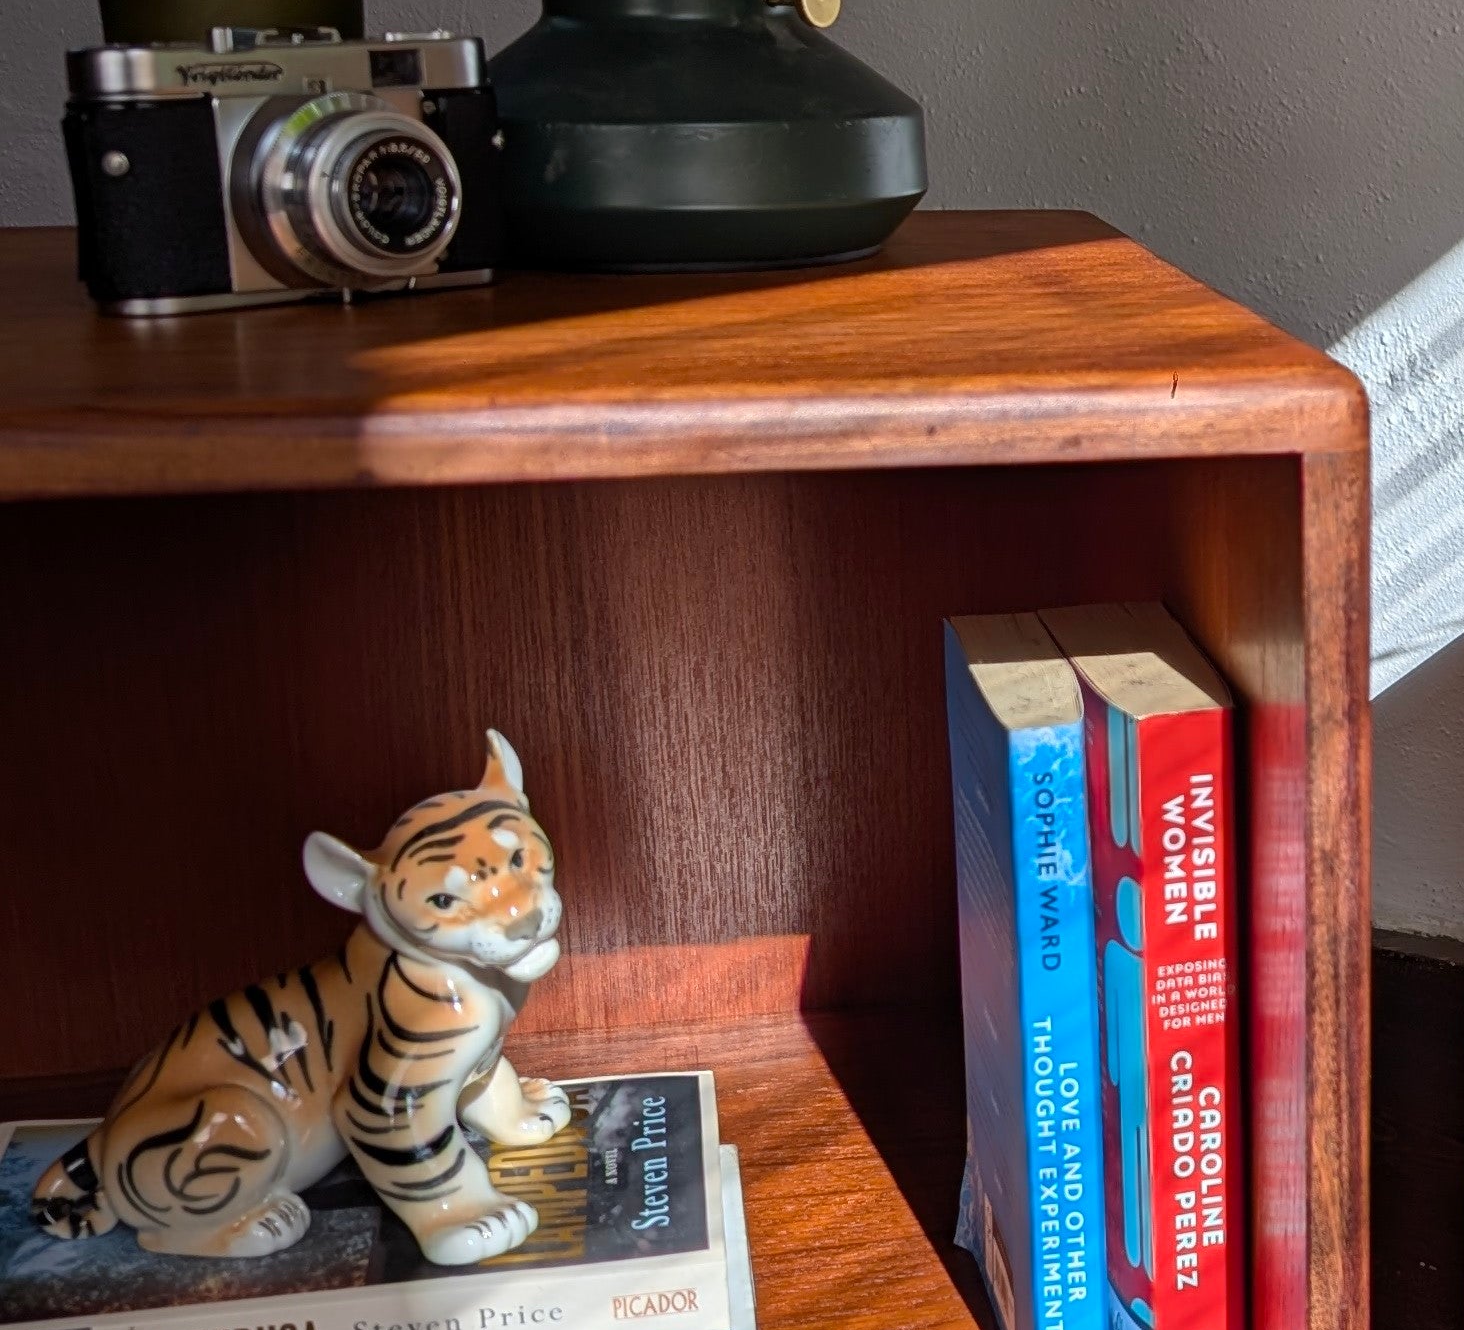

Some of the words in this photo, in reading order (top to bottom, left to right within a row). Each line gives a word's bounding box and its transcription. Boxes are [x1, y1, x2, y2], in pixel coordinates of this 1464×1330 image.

[1033, 772, 1057, 877] SOPHIE
[1162, 794, 1188, 925] WOMEN
[1189, 773, 1218, 941] INVISIBLE
[1040, 885, 1061, 971] WARD
[1151, 992, 1166, 1005] IN
[1170, 990, 1181, 1003] A
[1155, 975, 1194, 991] DATA
[1157, 957, 1226, 978] EXPOSING
[1158, 998, 1226, 1019] DESIGNED
[1163, 1016, 1192, 1031] FOR
[1195, 1011, 1225, 1026] MEN
[1033, 1016, 1057, 1154] THOUGHT
[1058, 1061, 1081, 1132] LOVE
[1170, 1050, 1196, 1178] CRIADO
[631, 1095, 668, 1152] Price
[478, 1087, 590, 1268] LAMPEDU
[603, 1148, 620, 1176] NOVEL
[631, 1156, 670, 1230] Steven
[1063, 1143, 1084, 1202] AND
[1198, 1086, 1225, 1247] CAROLINE
[1065, 1211, 1088, 1303] OTHER
[1175, 1190, 1199, 1291] PEREZ
[479, 1305, 564, 1330] Price
[612, 1289, 699, 1320] PICADOR
